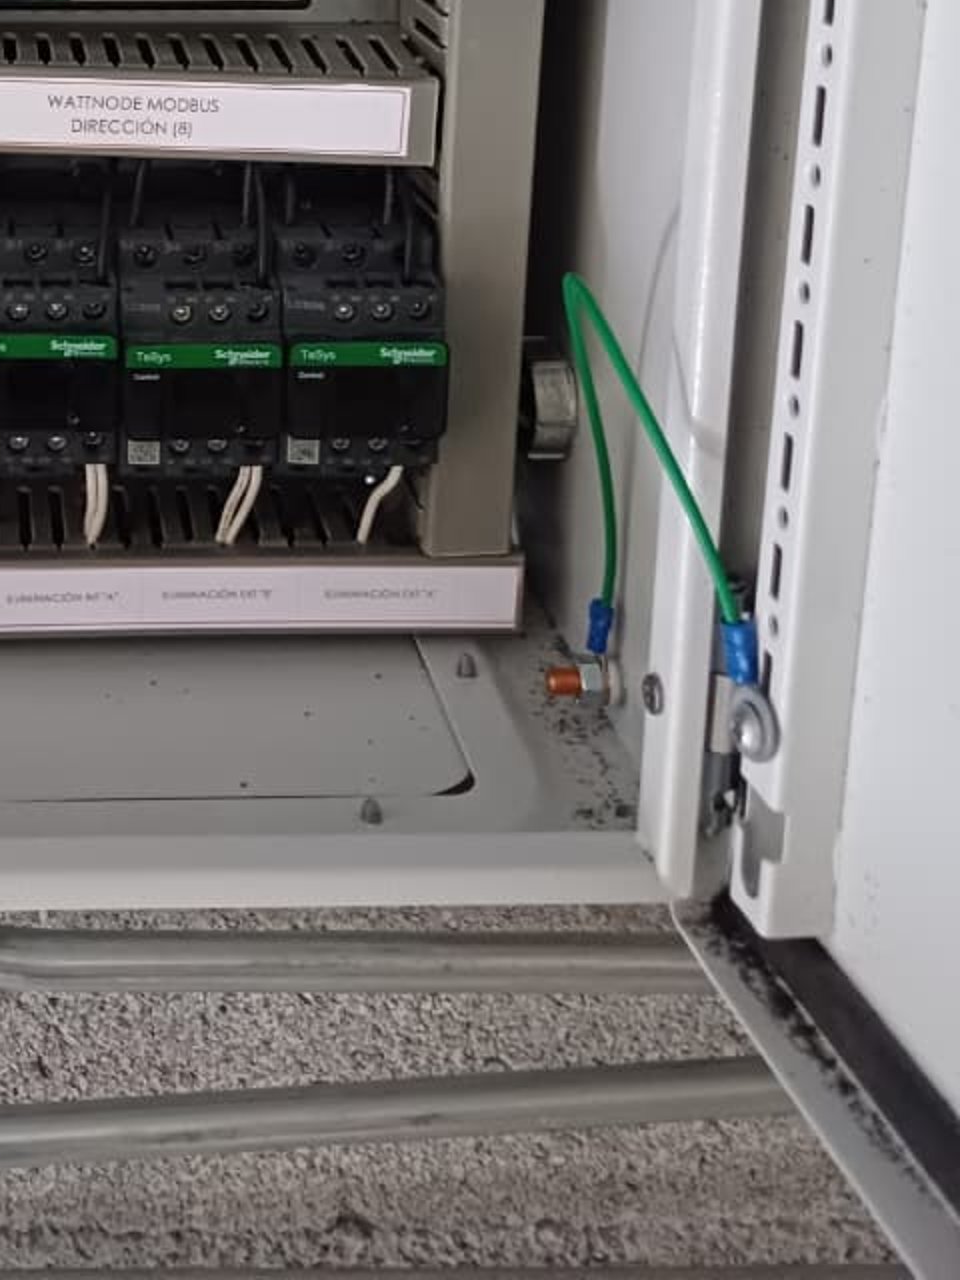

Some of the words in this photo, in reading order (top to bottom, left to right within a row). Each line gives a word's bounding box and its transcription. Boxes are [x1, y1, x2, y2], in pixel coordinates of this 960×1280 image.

[48, 95, 143, 111] WATTNODE
[147, 97, 220, 113] MODBUS
[71, 116, 167, 135] DIRECCIÓN
[173, 121, 193, 138] (8)
[50, 339, 107, 351] Schneider
[215, 349, 271, 360] Schneider
[380, 347, 437, 358] Schneider
